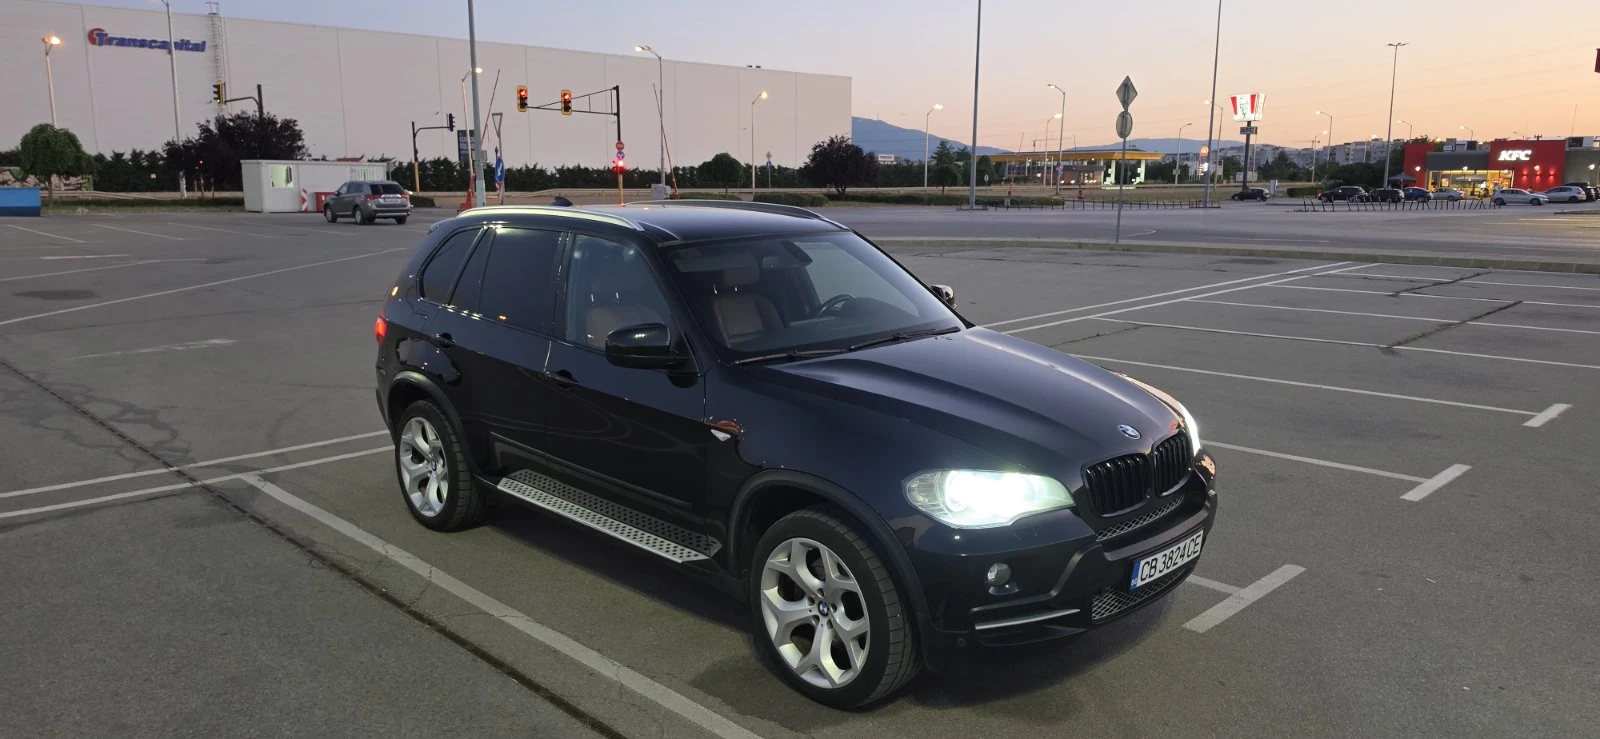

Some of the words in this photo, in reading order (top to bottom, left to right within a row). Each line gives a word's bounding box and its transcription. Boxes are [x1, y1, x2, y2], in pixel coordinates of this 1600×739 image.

[1498, 149, 1532, 160] KFC
[1140, 557, 1158, 582] CB
[1158, 542, 1187, 574] 3824
[1186, 533, 1202, 558] CE
